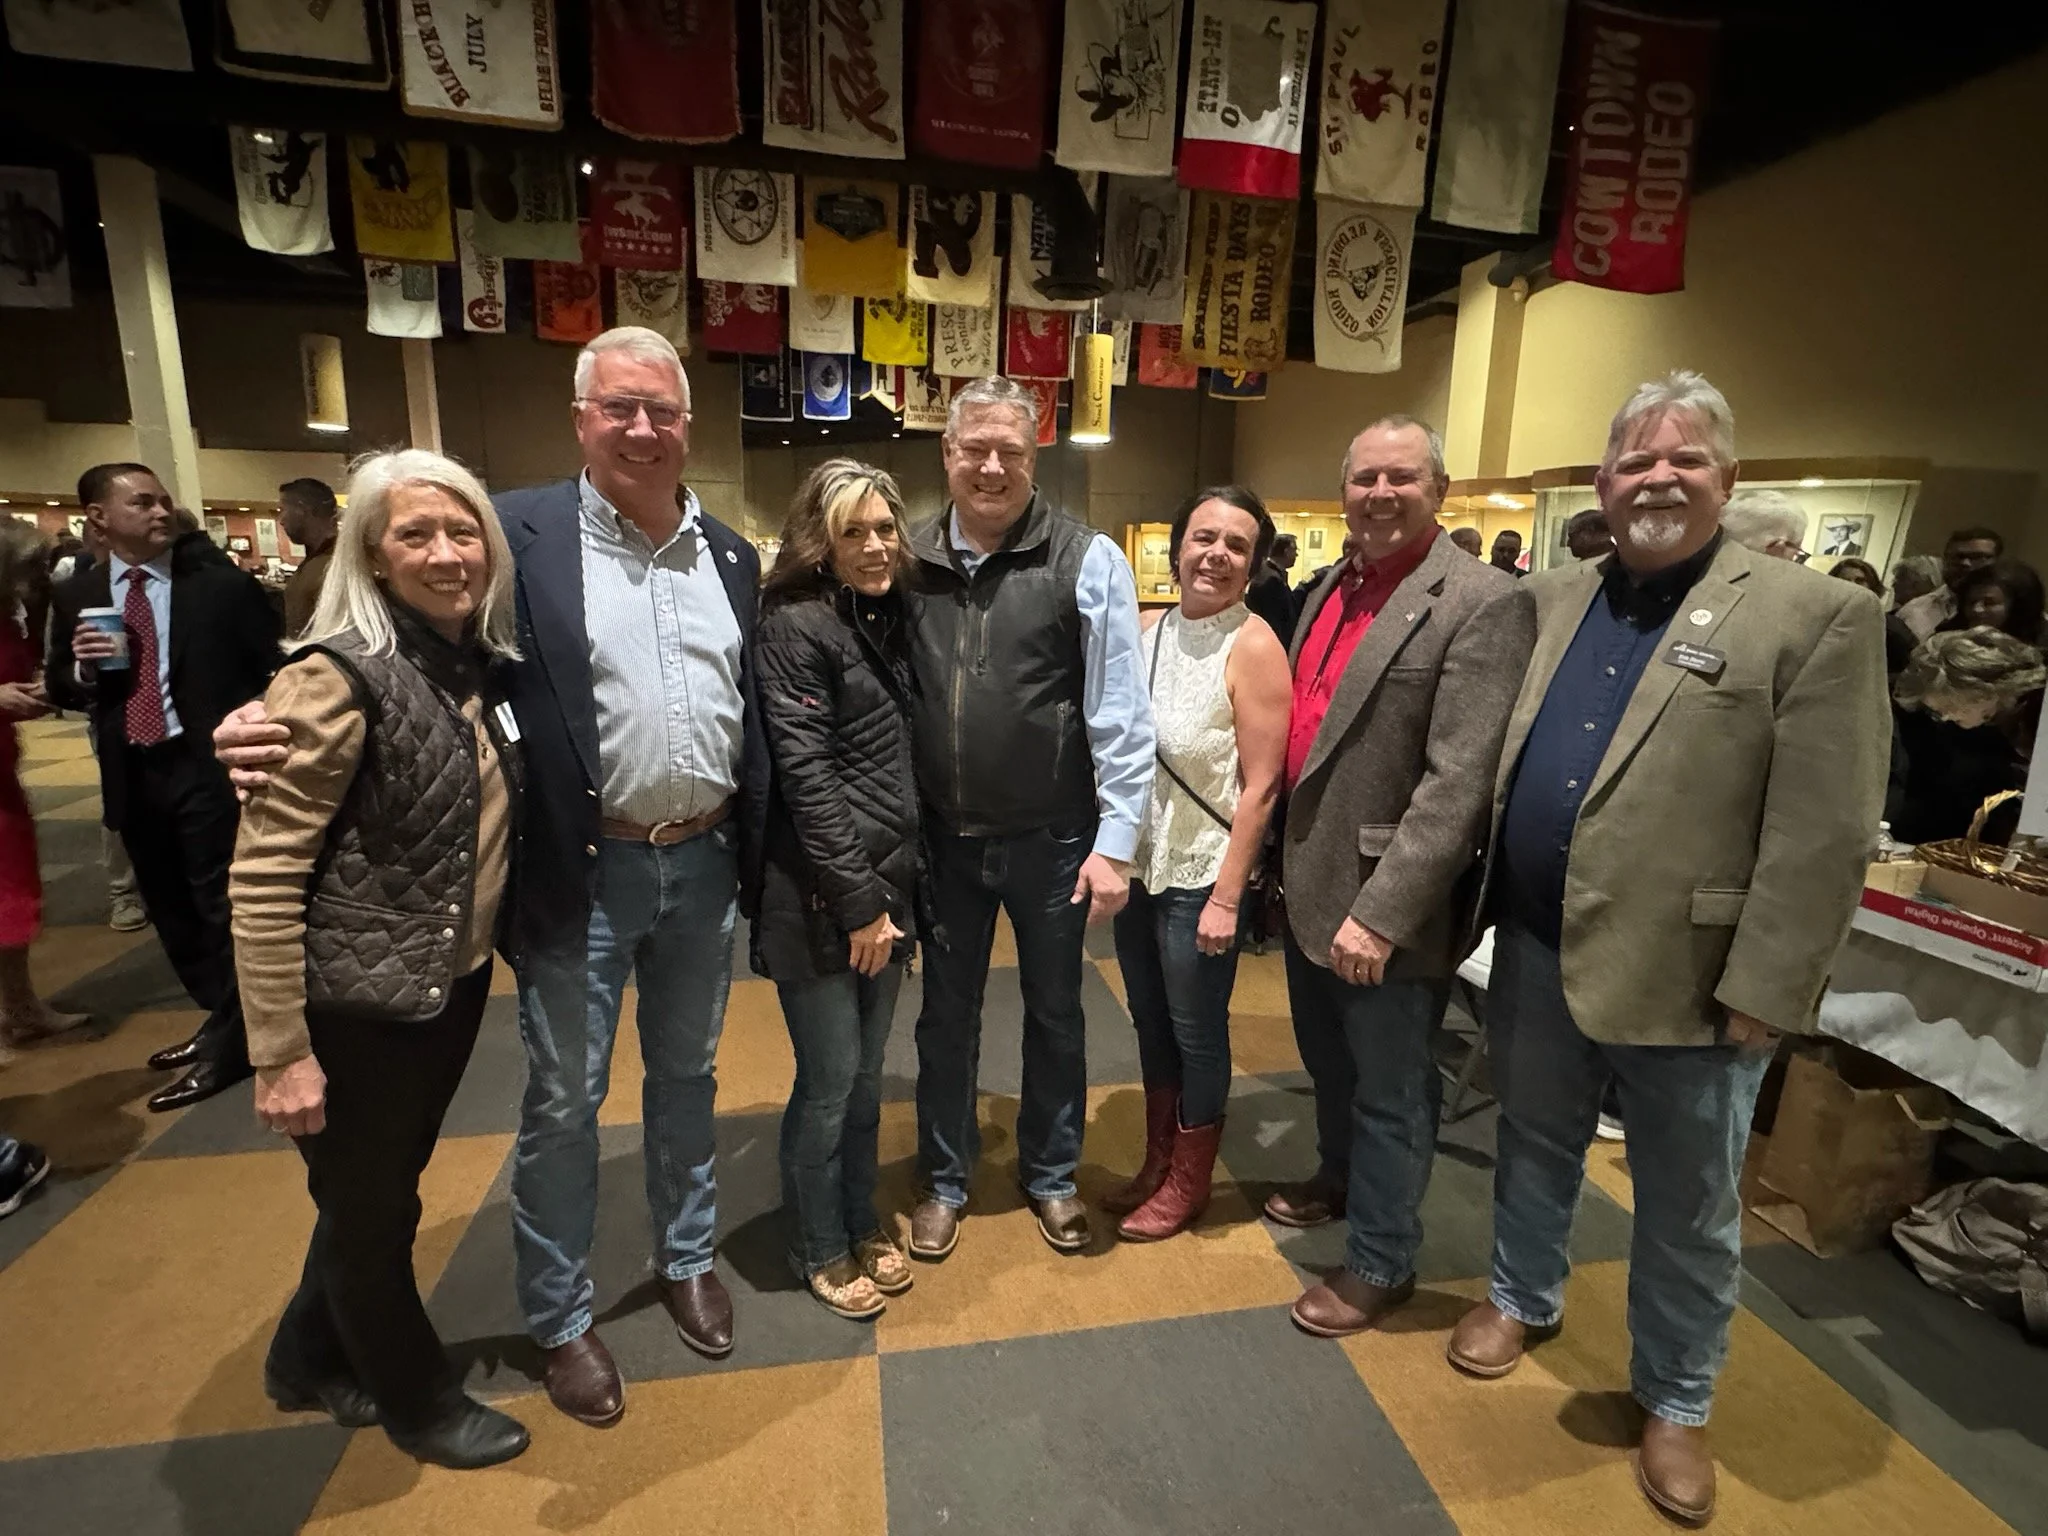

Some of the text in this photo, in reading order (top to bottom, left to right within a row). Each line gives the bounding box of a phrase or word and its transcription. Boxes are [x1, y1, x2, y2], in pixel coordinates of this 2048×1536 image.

[465, 12, 488, 73] JULY
[1327, 24, 1361, 101] PAUL
[536, 65, 555, 113] BELLE
[1414, 39, 1438, 152] RODEO
[1573, 26, 1642, 277] COWTOWN
[1629, 81, 1696, 245] RODEO
[1218, 200, 1251, 357] FIESTA DAYS
[1249, 244, 1276, 323] RODEO
[1904, 905, 1939, 925] Digital
[1942, 918, 1987, 939] Opaque
